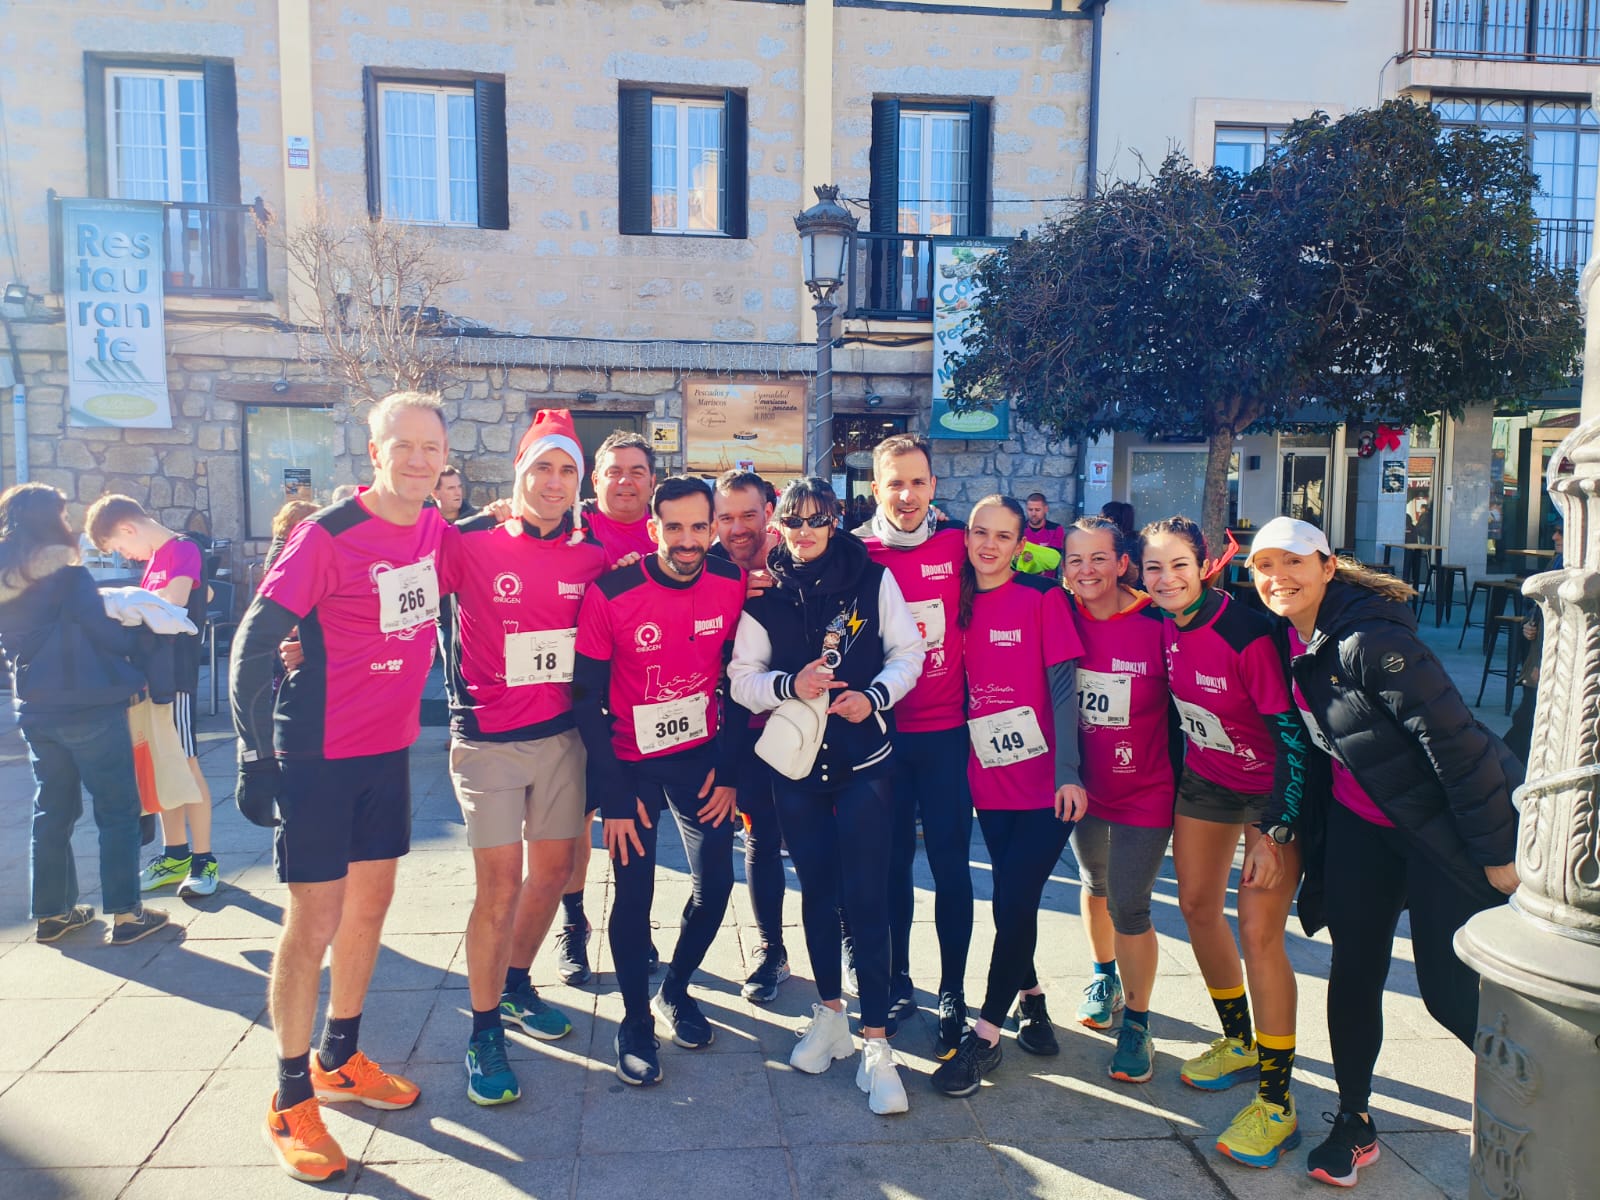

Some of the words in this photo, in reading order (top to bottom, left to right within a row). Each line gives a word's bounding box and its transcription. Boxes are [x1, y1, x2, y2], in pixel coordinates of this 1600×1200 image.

[77, 223, 151, 259] Res
[76, 259, 148, 294] tau
[78, 301, 151, 328] ran
[94, 328, 137, 362] te
[398, 588, 425, 614] 266
[989, 629, 1021, 643] BROOKLYN
[533, 652, 557, 671] 18
[1111, 658, 1147, 675] BROOKLYN
[1195, 670, 1227, 691] BROOKLYN
[1076, 690, 1109, 713] 120
[655, 716, 690, 738] 306
[1185, 716, 1207, 738] 79
[989, 731, 1025, 754] 149
